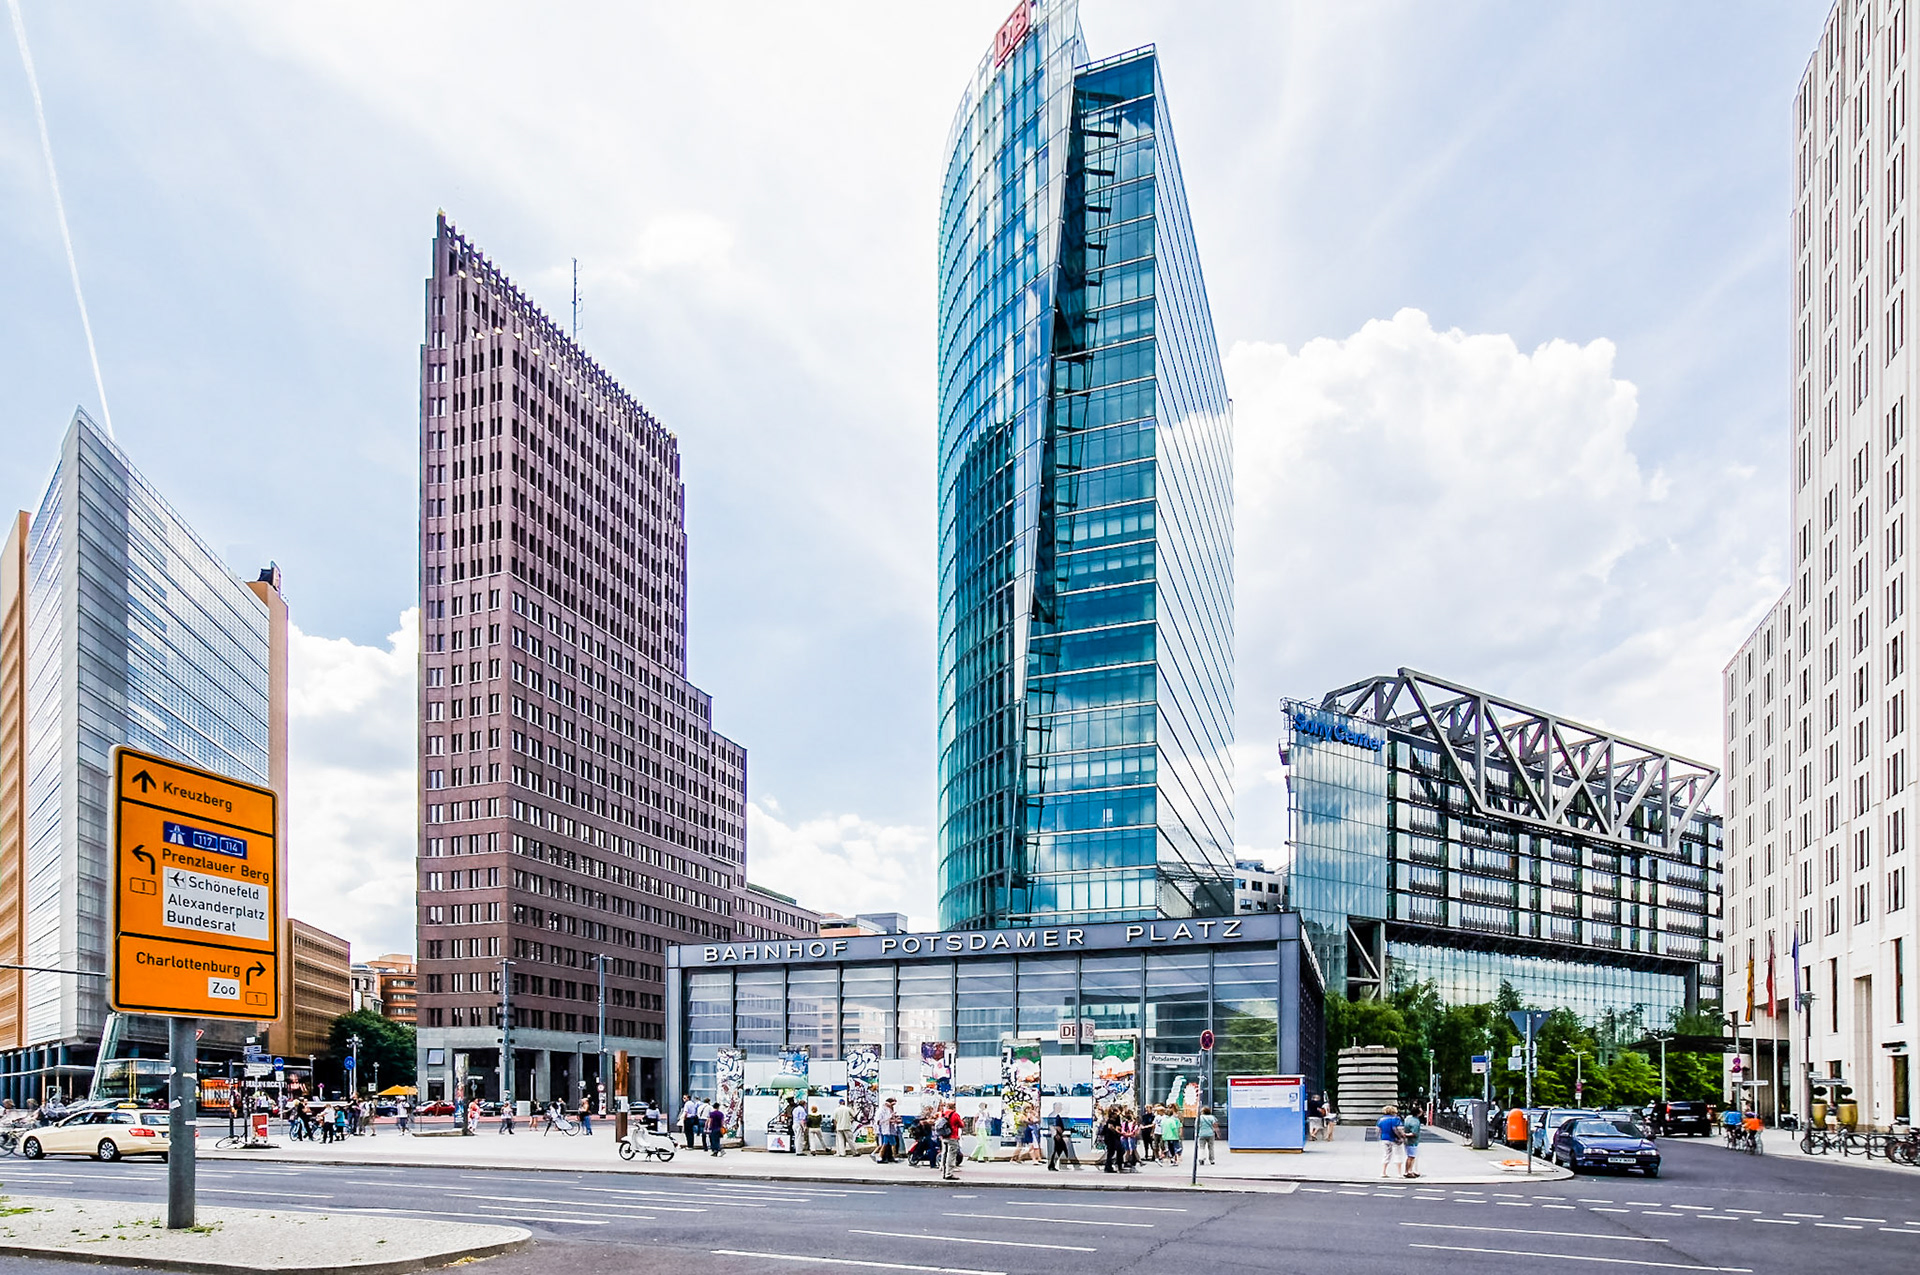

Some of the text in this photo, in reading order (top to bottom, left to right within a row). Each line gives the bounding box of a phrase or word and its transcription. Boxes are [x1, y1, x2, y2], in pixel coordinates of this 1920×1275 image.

[1293, 713, 1385, 752] Sony Center
[163, 781, 233, 812] Kreuzberg
[198, 835, 238, 852] 117 114
[162, 848, 269, 884] Prenzlauer Berg
[188, 876, 259, 900] Schönefeld
[167, 893, 265, 921] Alexanderplatz
[167, 910, 236, 932] Bundesrat
[703, 919, 1243, 963] BAHNHOF POTSDAMER PLATZ
[136, 951, 240, 977] Charlottenburg
[212, 981, 236, 996] Zoo
[1151, 1055, 1180, 1063] Potsdamer
